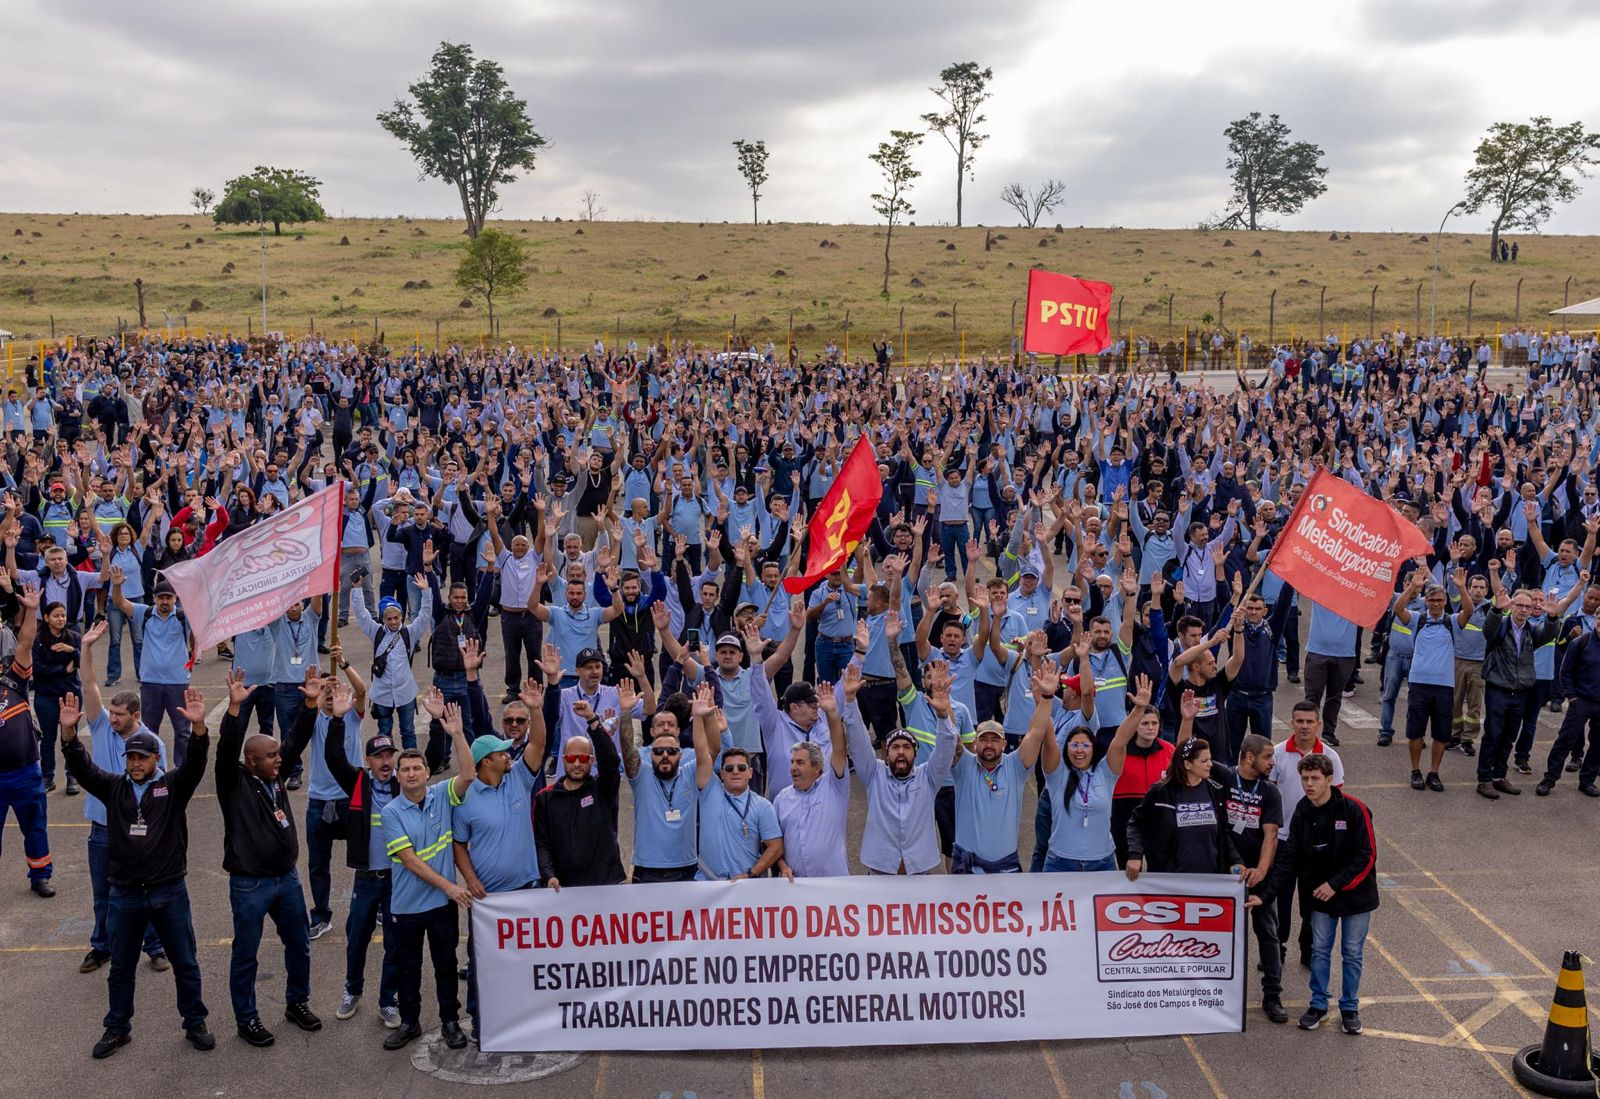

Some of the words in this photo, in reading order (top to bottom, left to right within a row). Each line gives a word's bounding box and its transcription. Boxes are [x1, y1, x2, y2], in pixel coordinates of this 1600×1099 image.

[1041, 300, 1098, 330] PSTU
[1296, 515, 1378, 576] Metalúrgicos
[1328, 508, 1388, 554] Sindicato
[1293, 546, 1302, 556] de
[1302, 550, 1314, 564] São
[497, 916, 564, 950] PELO
[571, 905, 798, 948] CANCELAMENTO
[806, 903, 860, 938] DAS
[867, 894, 1033, 937] DEMISSÕES,
[1040, 892, 1078, 932] JÁ!
[1105, 901, 1224, 925] CSP
[1109, 932, 1220, 962] Conlutas
[534, 957, 698, 990] ESTABILIDADE
[704, 956, 738, 984] NO
[744, 952, 860, 983] EMPREGO
[867, 949, 930, 980] PARA
[934, 948, 1011, 978] TODOS
[1017, 947, 1048, 976] OS
[1104, 966, 1141, 975] CENTRAL
[1188, 965, 1226, 973] POPULAR
[1107, 1001, 1121, 1010] São
[1123, 1001, 1141, 1010] José
[1144, 1000, 1158, 1008] dos
[1160, 1000, 1190, 1009] Campos
[1198, 999, 1224, 1008] Região
[1108, 990, 1144, 998] Sindicato
[1146, 989, 1160, 998] dos
[1162, 988, 1211, 998] Metalúrgicos
[558, 997, 761, 1029] TRABALHADORES
[768, 996, 800, 1025] DA
[806, 992, 914, 1025] GENERAL
[919, 989, 1026, 1020] MOTORS!
